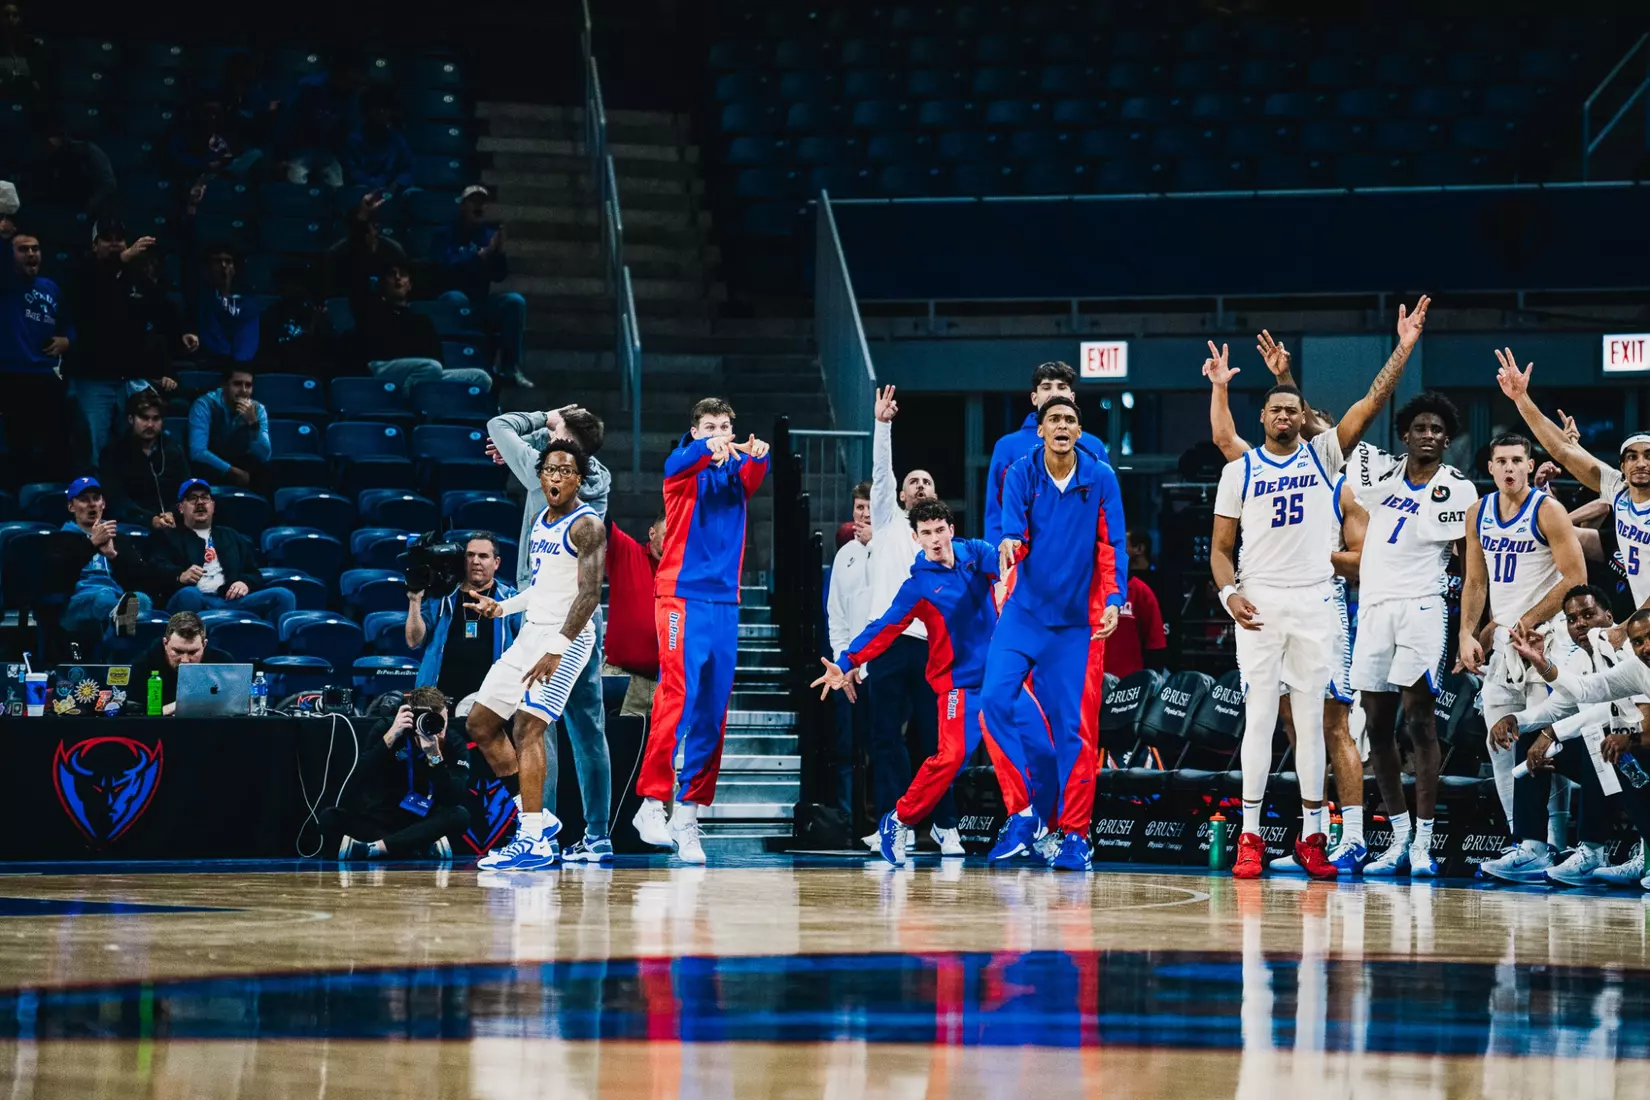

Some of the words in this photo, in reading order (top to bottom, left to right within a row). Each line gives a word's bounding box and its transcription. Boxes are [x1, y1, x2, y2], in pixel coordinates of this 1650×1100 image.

[1088, 347, 1119, 372] EXIT
[1611, 340, 1645, 364] EXIT
[1271, 493, 1304, 528] 35
[1386, 516, 1408, 544] 1
[1494, 553, 1517, 583] 10
[1628, 545, 1640, 575] 5
[1114, 686, 1141, 703] RUSH
[1169, 690, 1191, 707] RUSH
[1220, 688, 1242, 705] RUSH
[965, 816, 995, 830] RUSH
[1105, 819, 1135, 835] RUSH
[1152, 821, 1186, 837] RUSH
[1471, 835, 1507, 851] RUSH
